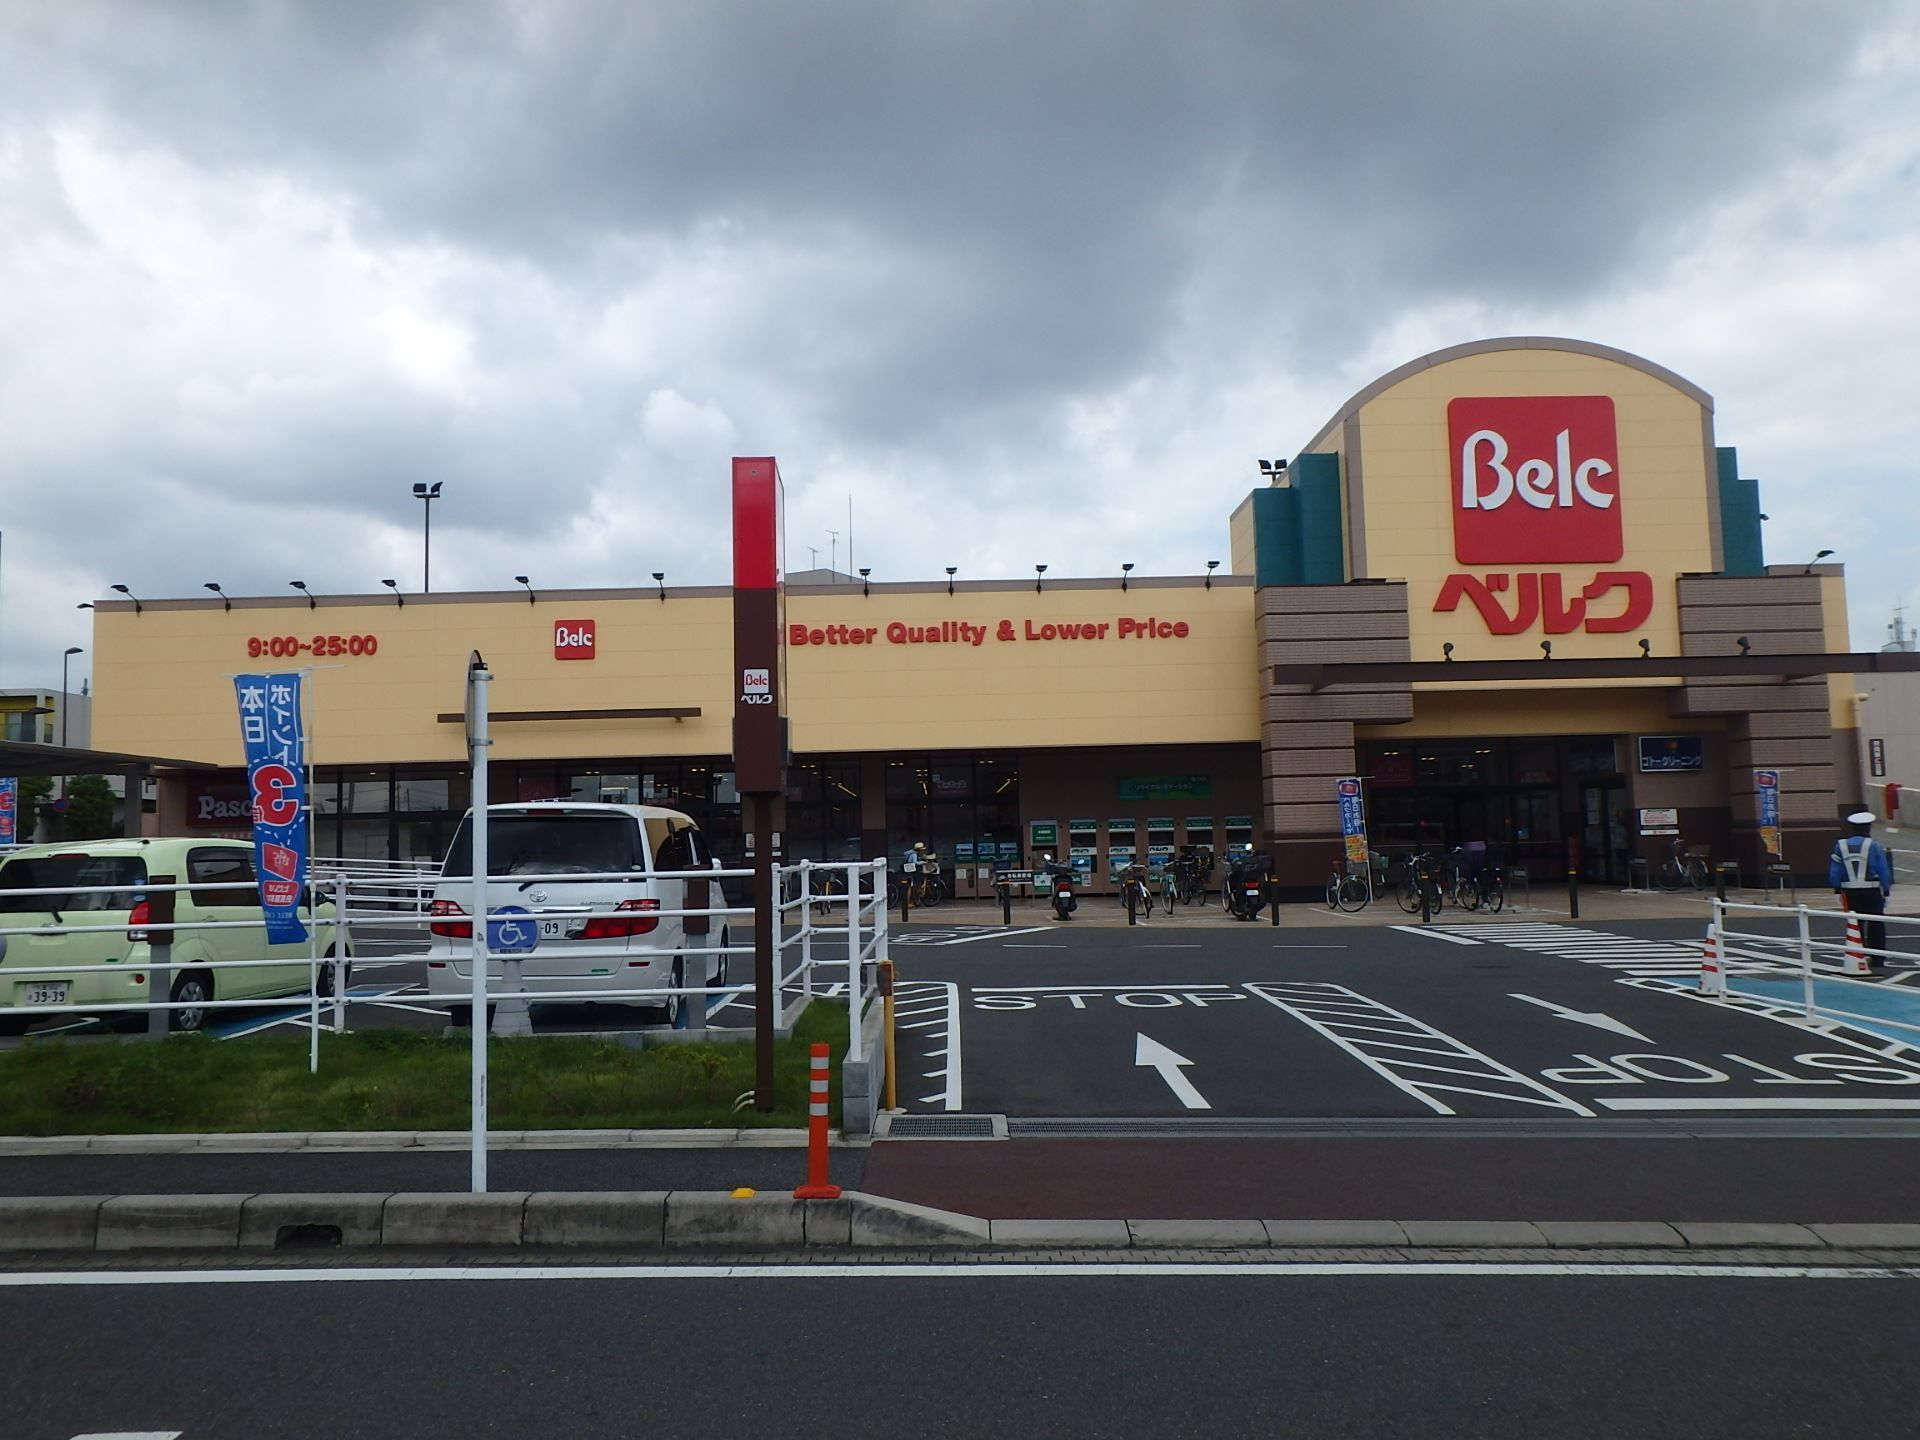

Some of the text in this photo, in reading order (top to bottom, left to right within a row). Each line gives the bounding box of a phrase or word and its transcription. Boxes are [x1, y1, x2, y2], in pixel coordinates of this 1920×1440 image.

[1461, 428, 1615, 511] Belc
[1432, 571, 1653, 635] ベルク
[556, 626, 593, 647] Belc
[789, 617, 1190, 646] Better Quality & Lower Price
[745, 673, 768, 686] Belc
[740, 694, 773, 705] ベルク
[197, 795, 254, 819] Pasc
[33, 990, 66, 1003] 39-39
[973, 993, 1247, 1010] STOP
[1540, 1053, 1920, 1085] STOP
